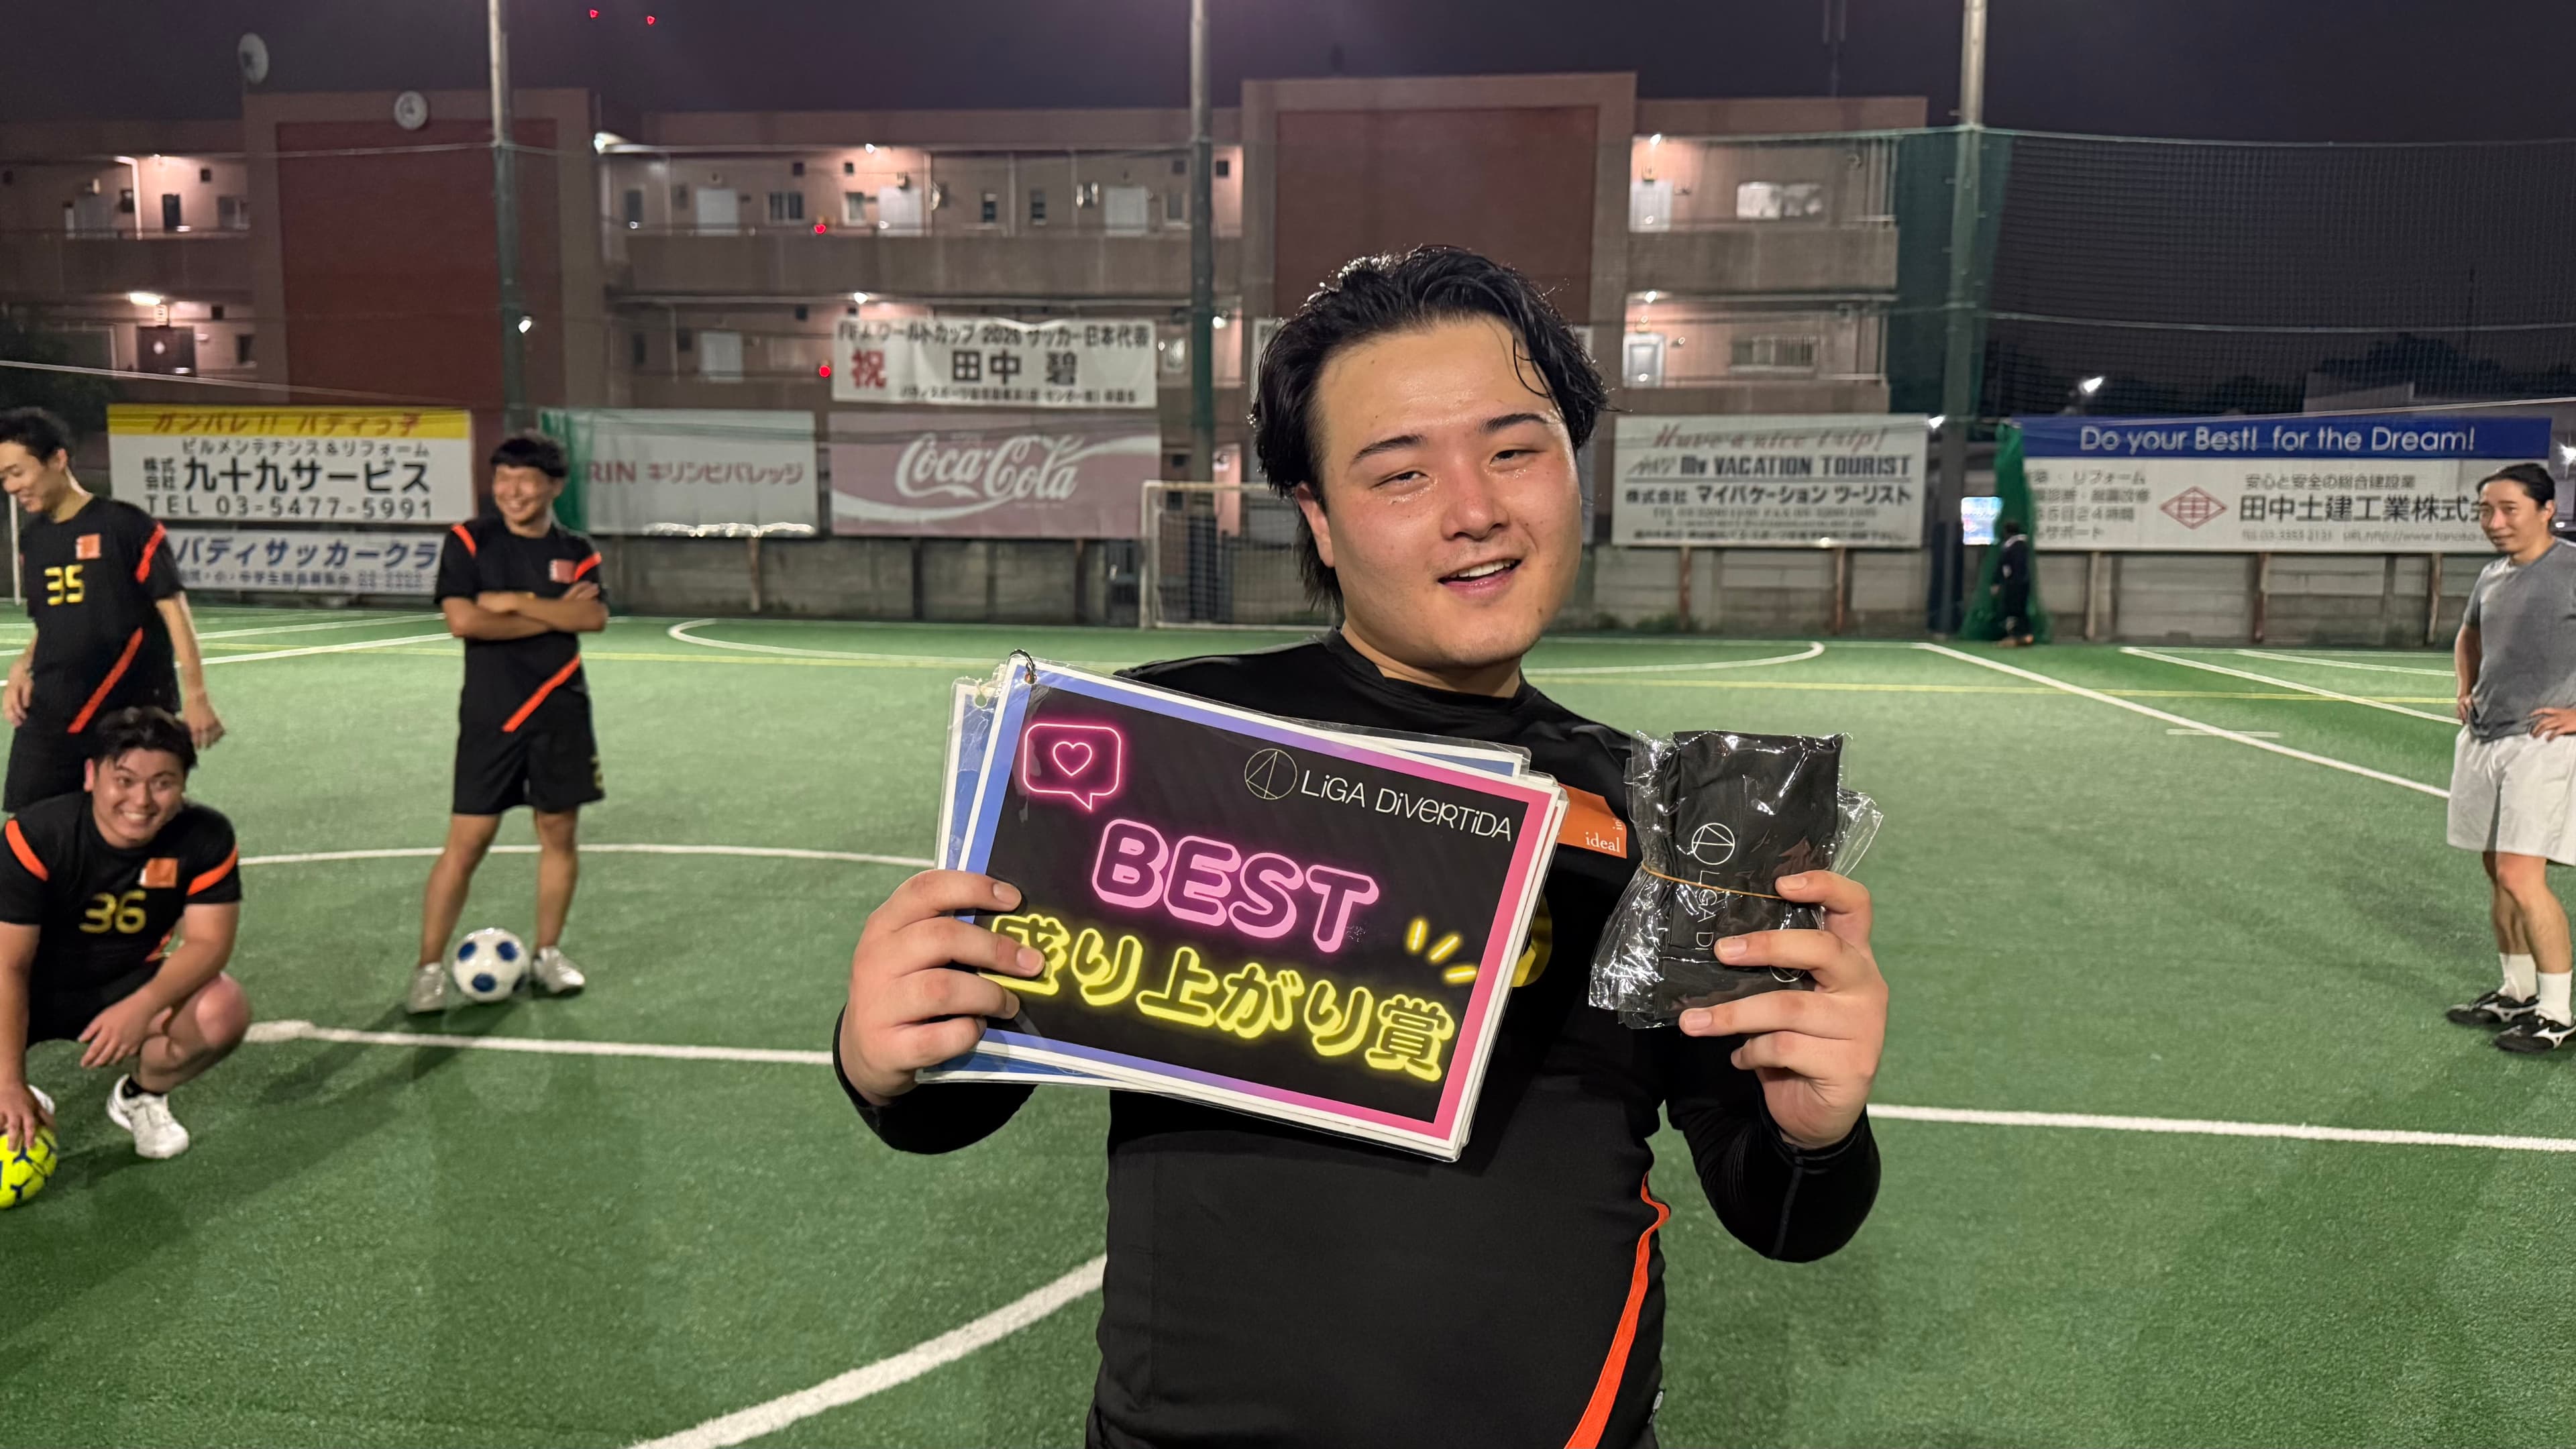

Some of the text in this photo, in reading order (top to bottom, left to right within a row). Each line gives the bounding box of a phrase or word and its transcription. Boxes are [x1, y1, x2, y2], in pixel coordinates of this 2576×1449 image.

[851, 348, 887, 389] 祝
[953, 350, 1021, 384] 田中
[2080, 426, 2475, 455] Do your Best! for the Dream!
[183, 456, 431, 494] 九十九サービス
[584, 460, 804, 485] RIN キリンビバレッジ
[894, 433, 1087, 500] Coca-Cola
[1714, 455, 1811, 476] VACATION
[1821, 455, 1912, 476] TOURIST
[144, 494, 433, 519] TEL 03-5477-5991
[1626, 489, 1687, 504] 株式会社
[1833, 484, 1912, 504] ツーリスト
[176, 537, 439, 569] バディサッカークラ
[44, 564, 86, 606] 35
[1585, 831, 1620, 853] ideal
[1091, 818, 1380, 953] BEST
[1695, 870, 1721, 923] LGA
[78, 890, 147, 934] 36
